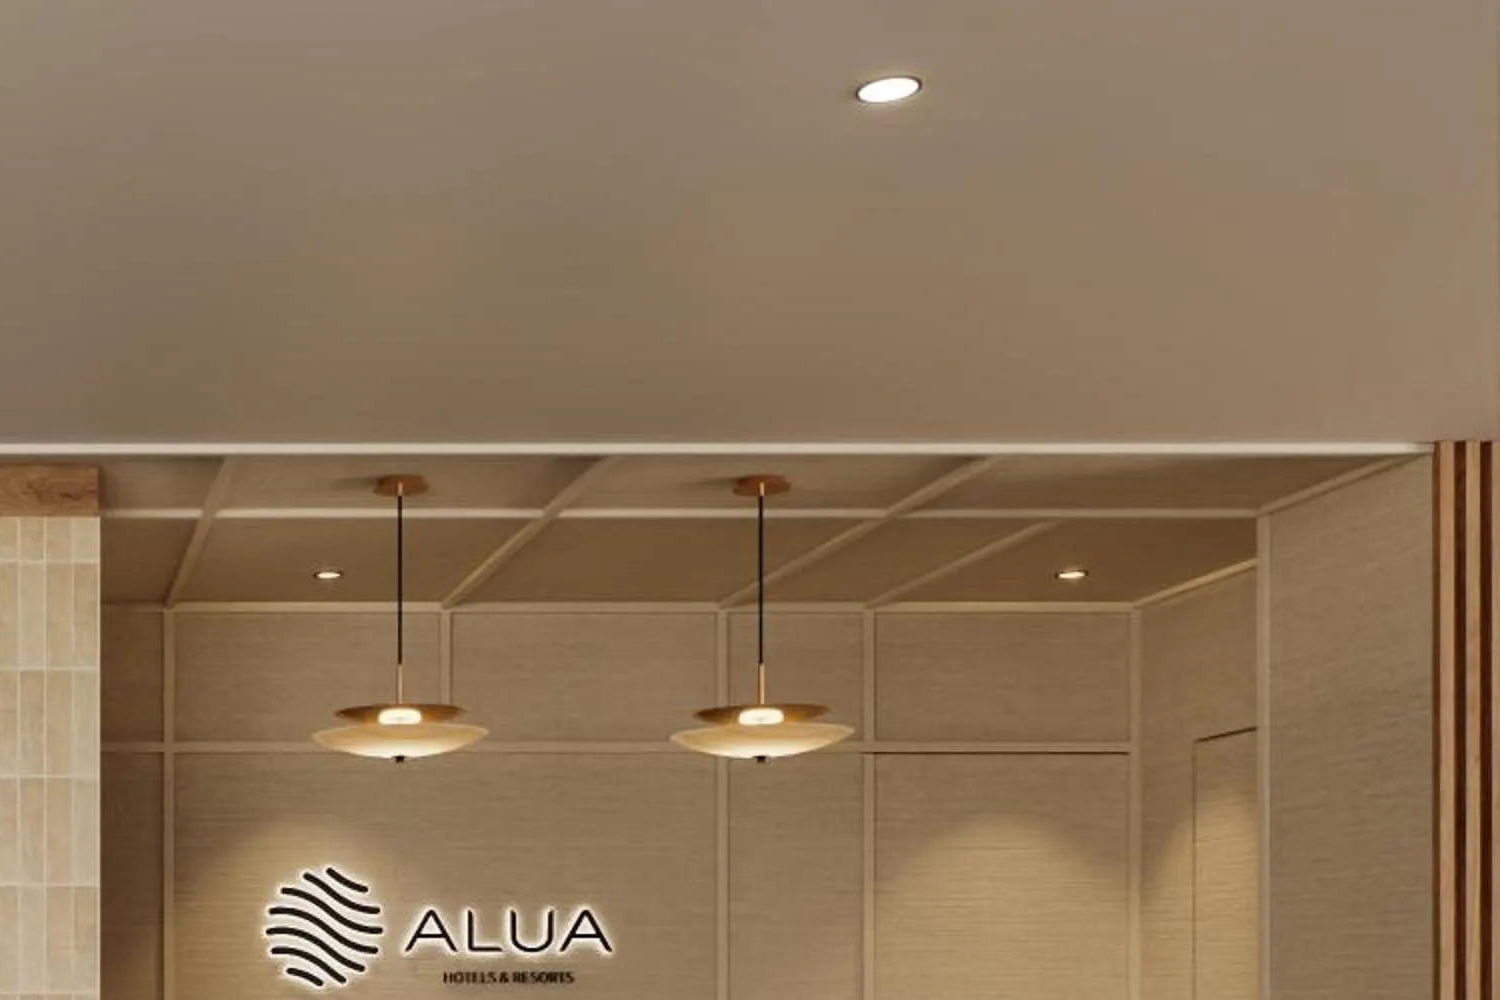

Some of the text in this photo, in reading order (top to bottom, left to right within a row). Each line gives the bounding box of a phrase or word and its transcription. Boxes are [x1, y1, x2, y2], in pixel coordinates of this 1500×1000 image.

[404, 908, 613, 953] ALUA
[442, 971, 576, 985] HOTELS & RESORTS
